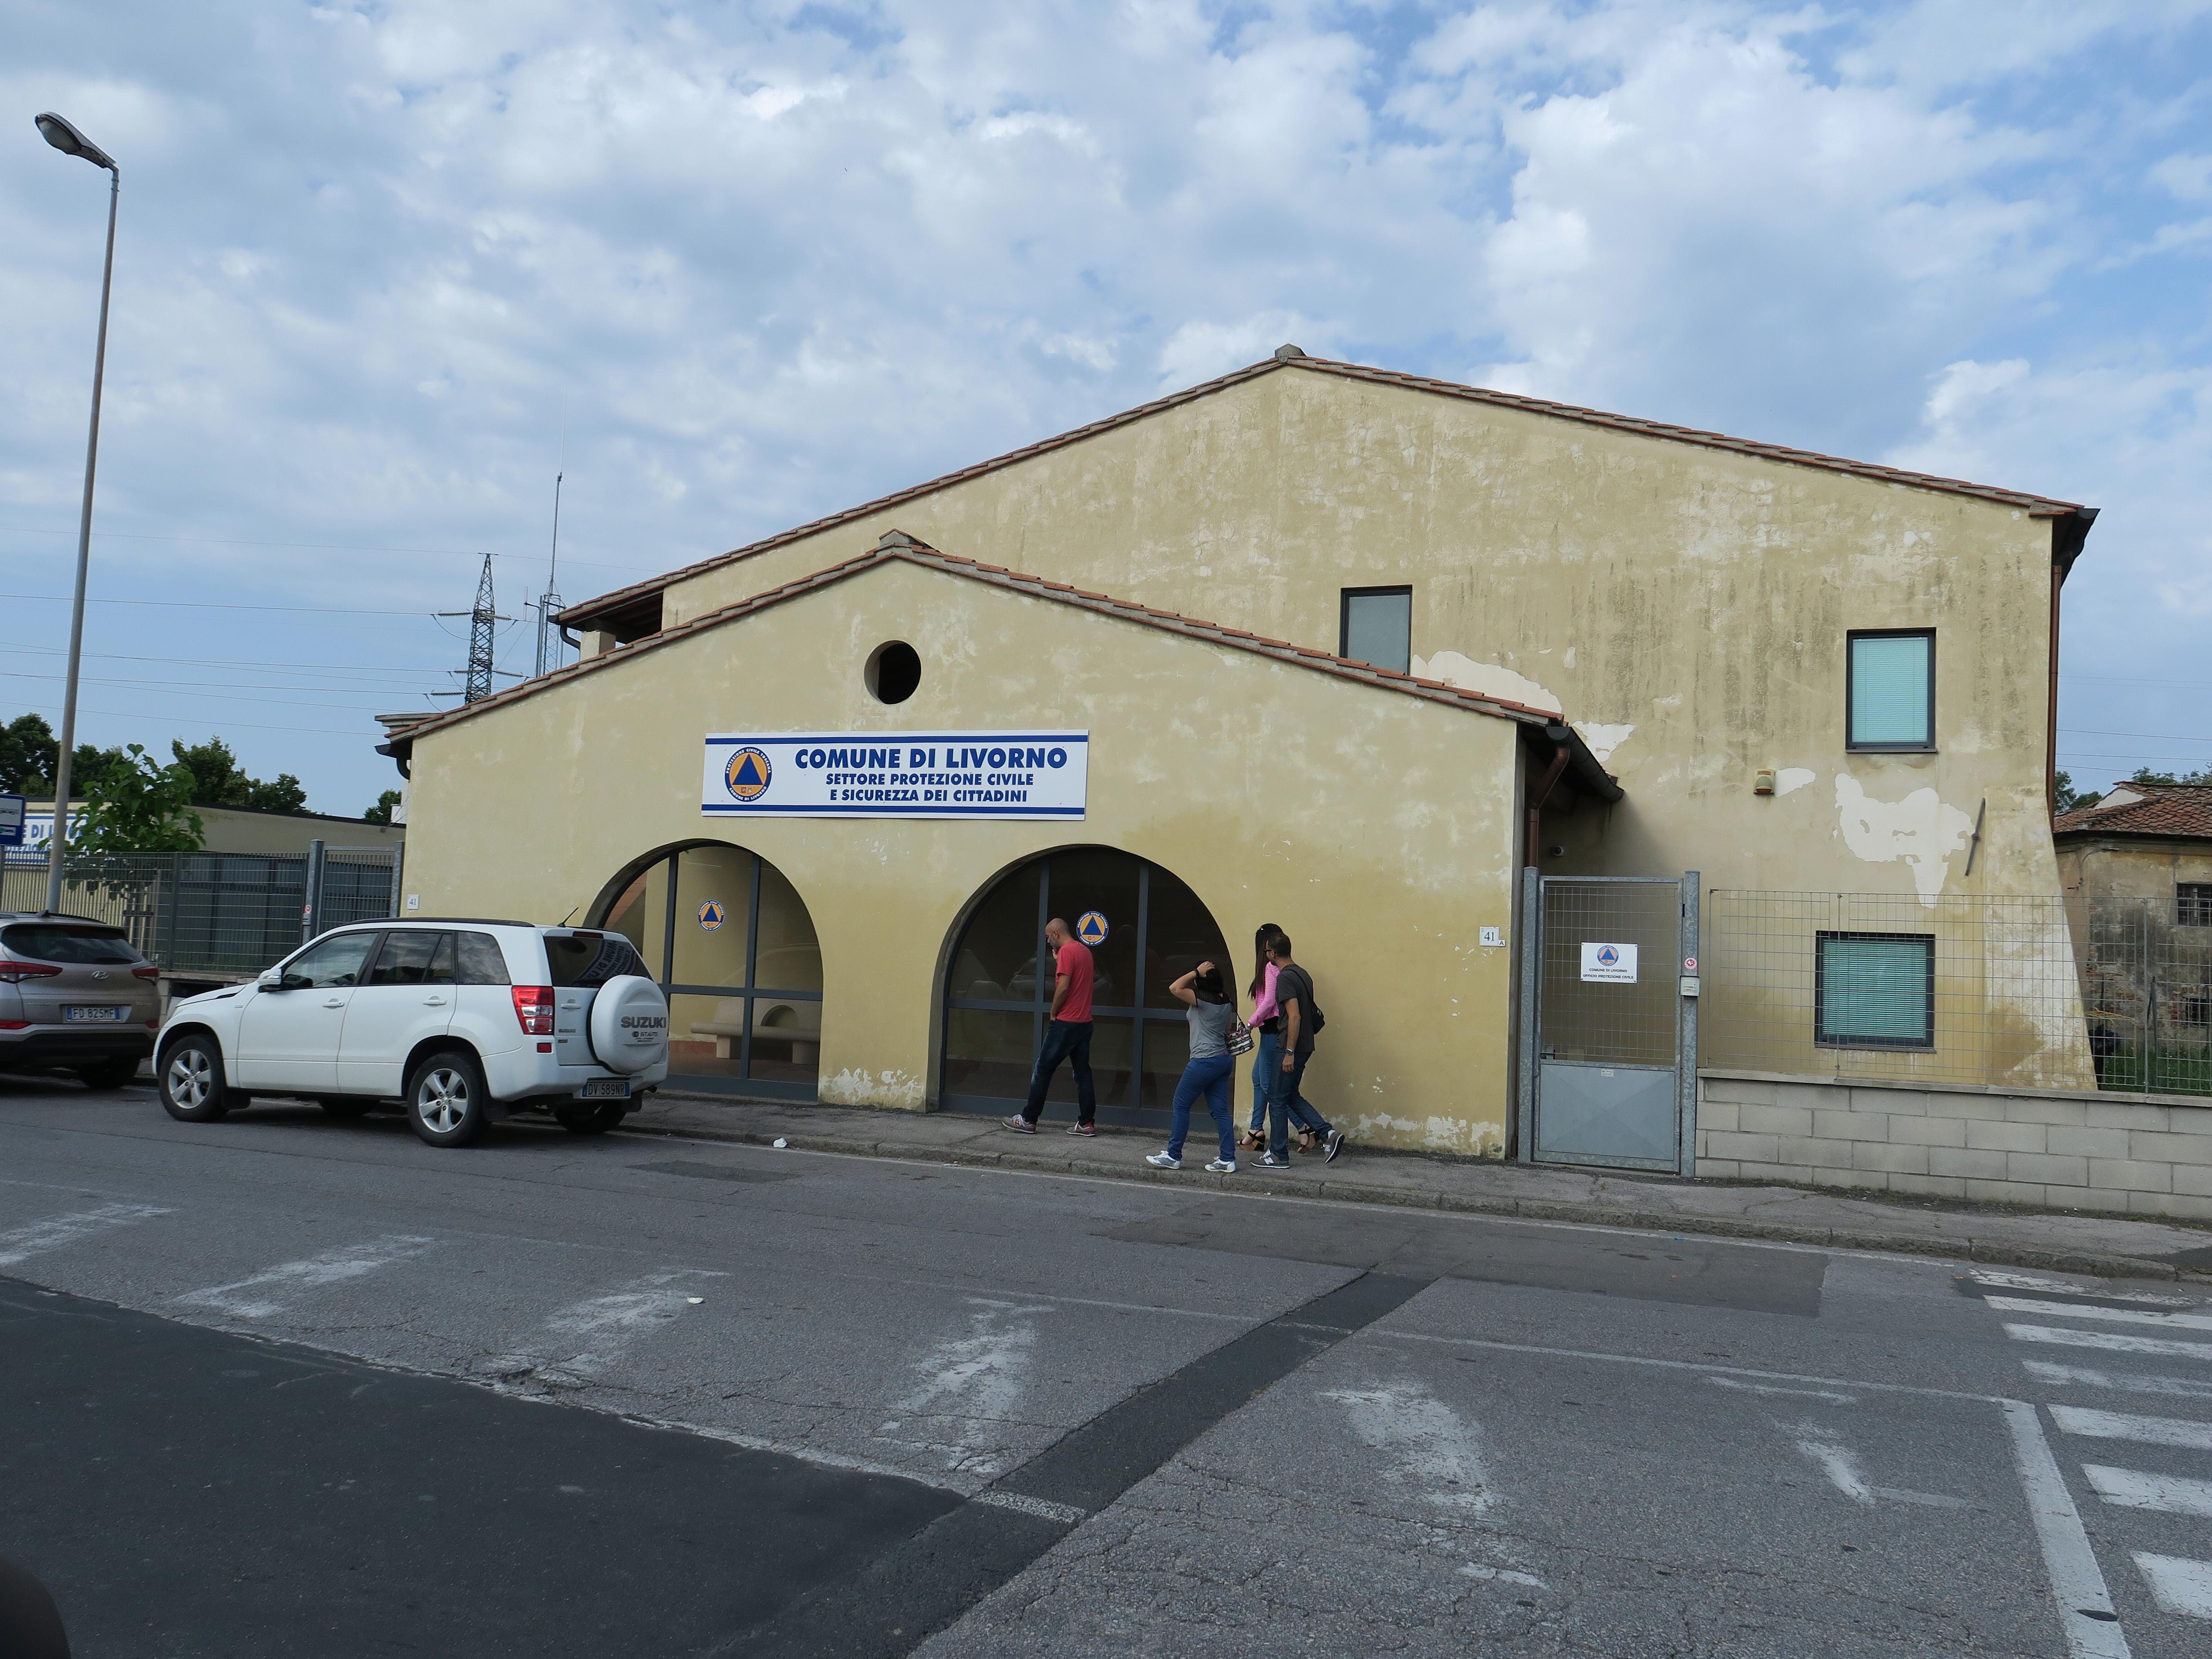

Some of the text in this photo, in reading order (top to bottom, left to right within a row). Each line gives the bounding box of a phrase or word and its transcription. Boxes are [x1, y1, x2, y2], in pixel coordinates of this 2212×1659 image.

[726, 749, 744, 774] PROTEZIONE
[760, 753, 771, 774] TOSCANA
[795, 748, 1067, 769] COMUNE DI LIVORNO
[826, 773, 1034, 785] SETTORE PROTEZIONE CIVILE
[729, 787, 744, 800] COMUNE
[750, 786, 767, 800] LIVORNO
[830, 789, 1027, 802] E SICUREZZA DEI CITTADINI
[30, 824, 44, 838] DI
[1484, 932, 1494, 941] 41
[73, 1008, 114, 1018] FD 825MF
[621, 1016, 666, 1028] SUZUKI
[588, 1084, 624, 1095] DV 589NR
